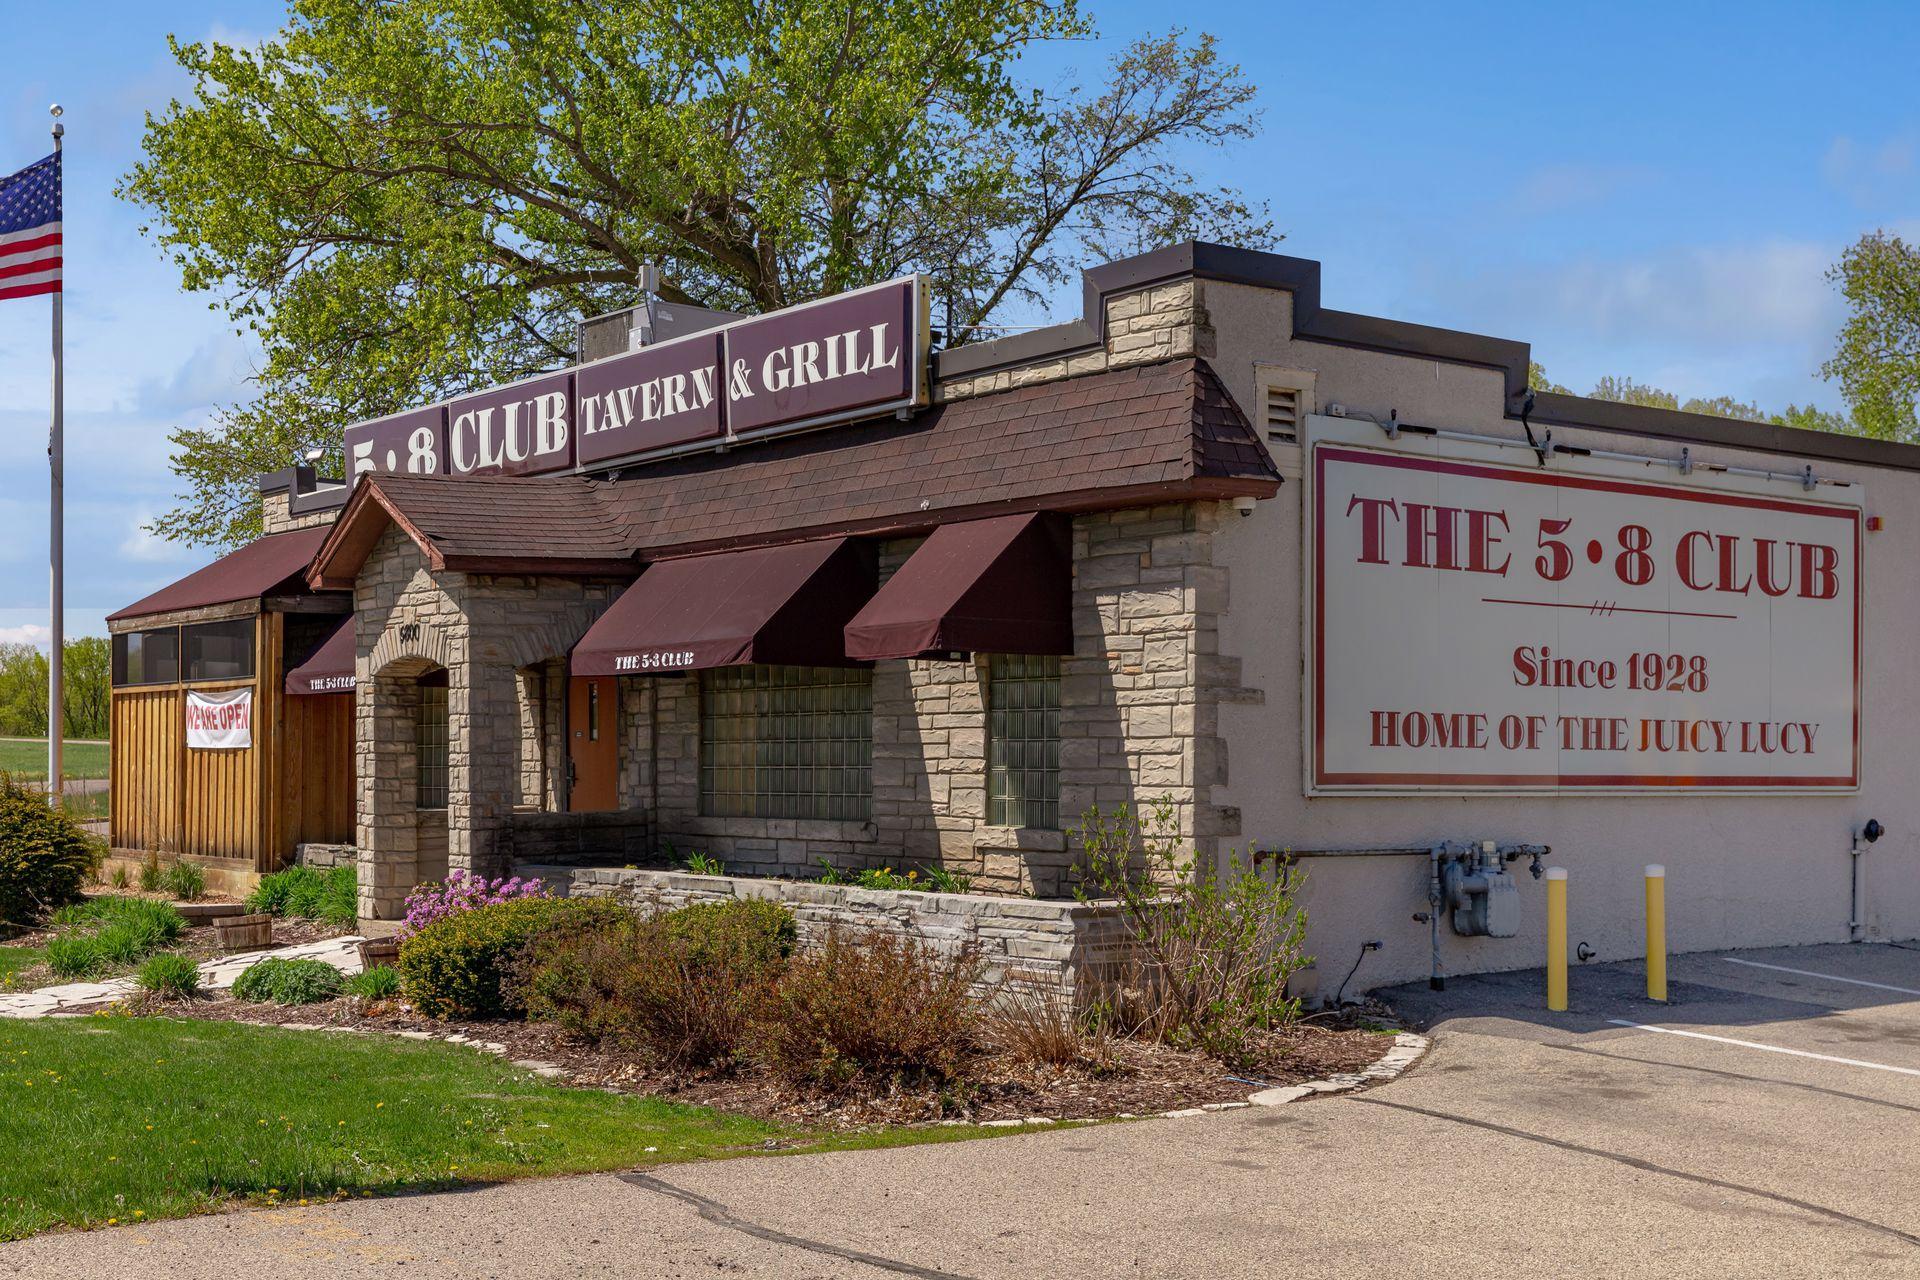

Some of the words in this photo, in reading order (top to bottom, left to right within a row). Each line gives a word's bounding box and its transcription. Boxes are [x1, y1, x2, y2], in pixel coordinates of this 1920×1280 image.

[452, 391, 568, 473] CLUB
[581, 365, 716, 435] TAVERN
[730, 358, 755, 401] &
[762, 322, 899, 392] GRILL
[1346, 493, 1512, 578] THE
[1676, 530, 1840, 600] CLUB
[614, 655, 640, 670] THE
[661, 651, 694, 667] CLUB
[1513, 646, 1618, 689] Since
[1626, 652, 1709, 694] 1928
[310, 679, 325, 690] THE
[186, 704, 200, 730] WE
[200, 705, 218, 730] ARE
[219, 703, 249, 730] OPEN
[1369, 711, 1489, 750] HOME
[1498, 714, 1547, 750] OF
[1556, 714, 1630, 752] THE
[1637, 718, 1732, 752] JUICY
[1740, 721, 1820, 754] LUCY
